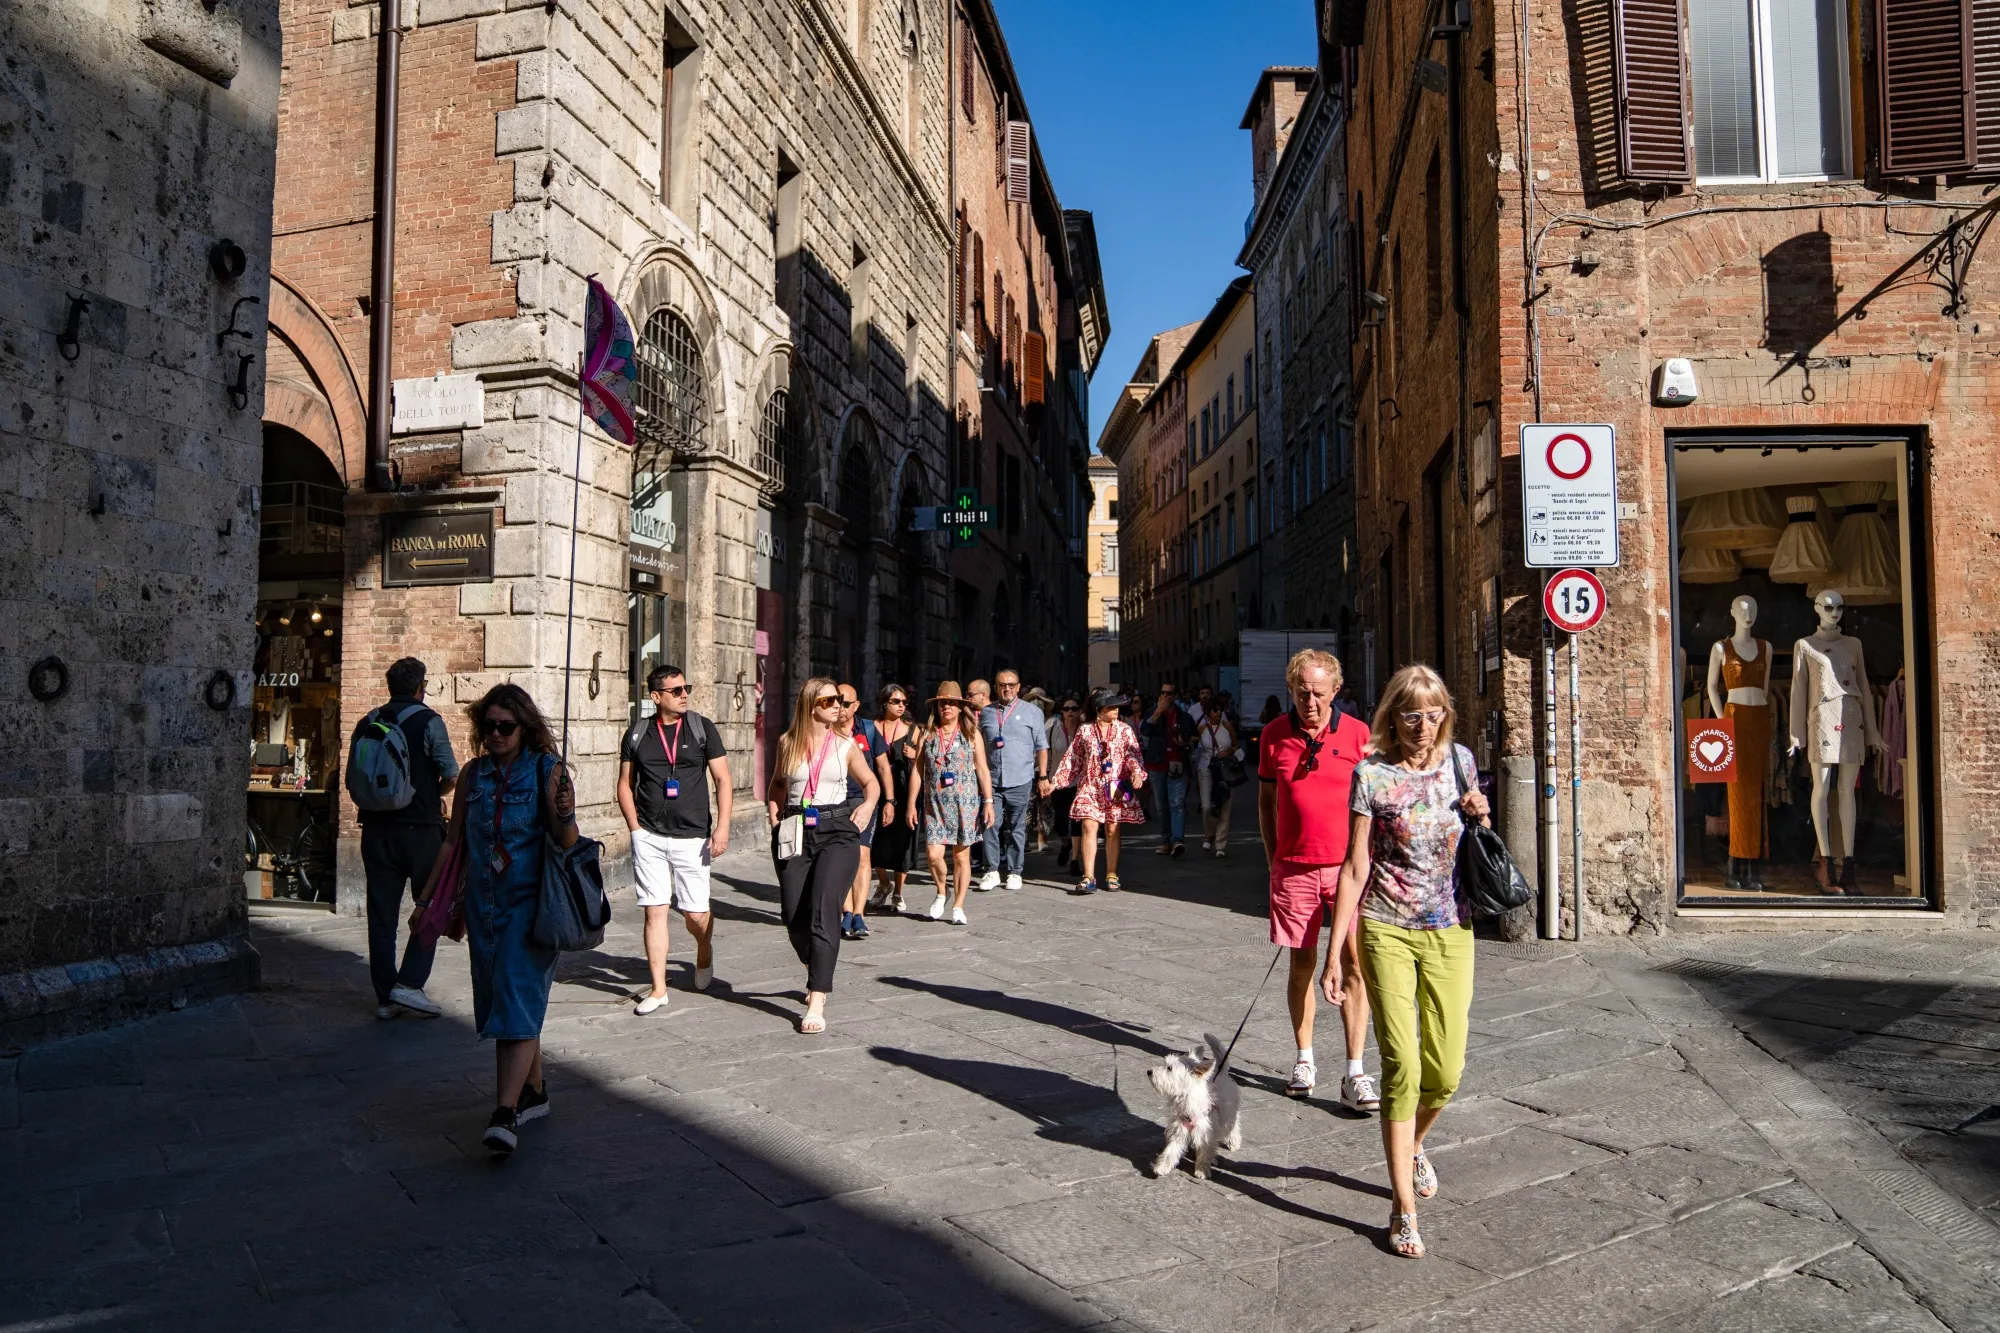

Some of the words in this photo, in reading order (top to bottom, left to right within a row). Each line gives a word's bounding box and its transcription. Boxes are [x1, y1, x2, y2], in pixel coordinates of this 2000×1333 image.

[417, 388, 456, 398] VICOLO
[398, 409, 434, 420] DELLA
[439, 404, 475, 416] TORRE
[391, 536, 434, 552] BANCA
[448, 533, 487, 549] ROMA
[361, 577, 366, 586] 2
[1561, 587, 1590, 614] 15
[1703, 729, 1729, 741] MARCO
[1690, 735, 1708, 772] TREEBLEND
[1713, 739, 1734, 772] RAMBALDI
